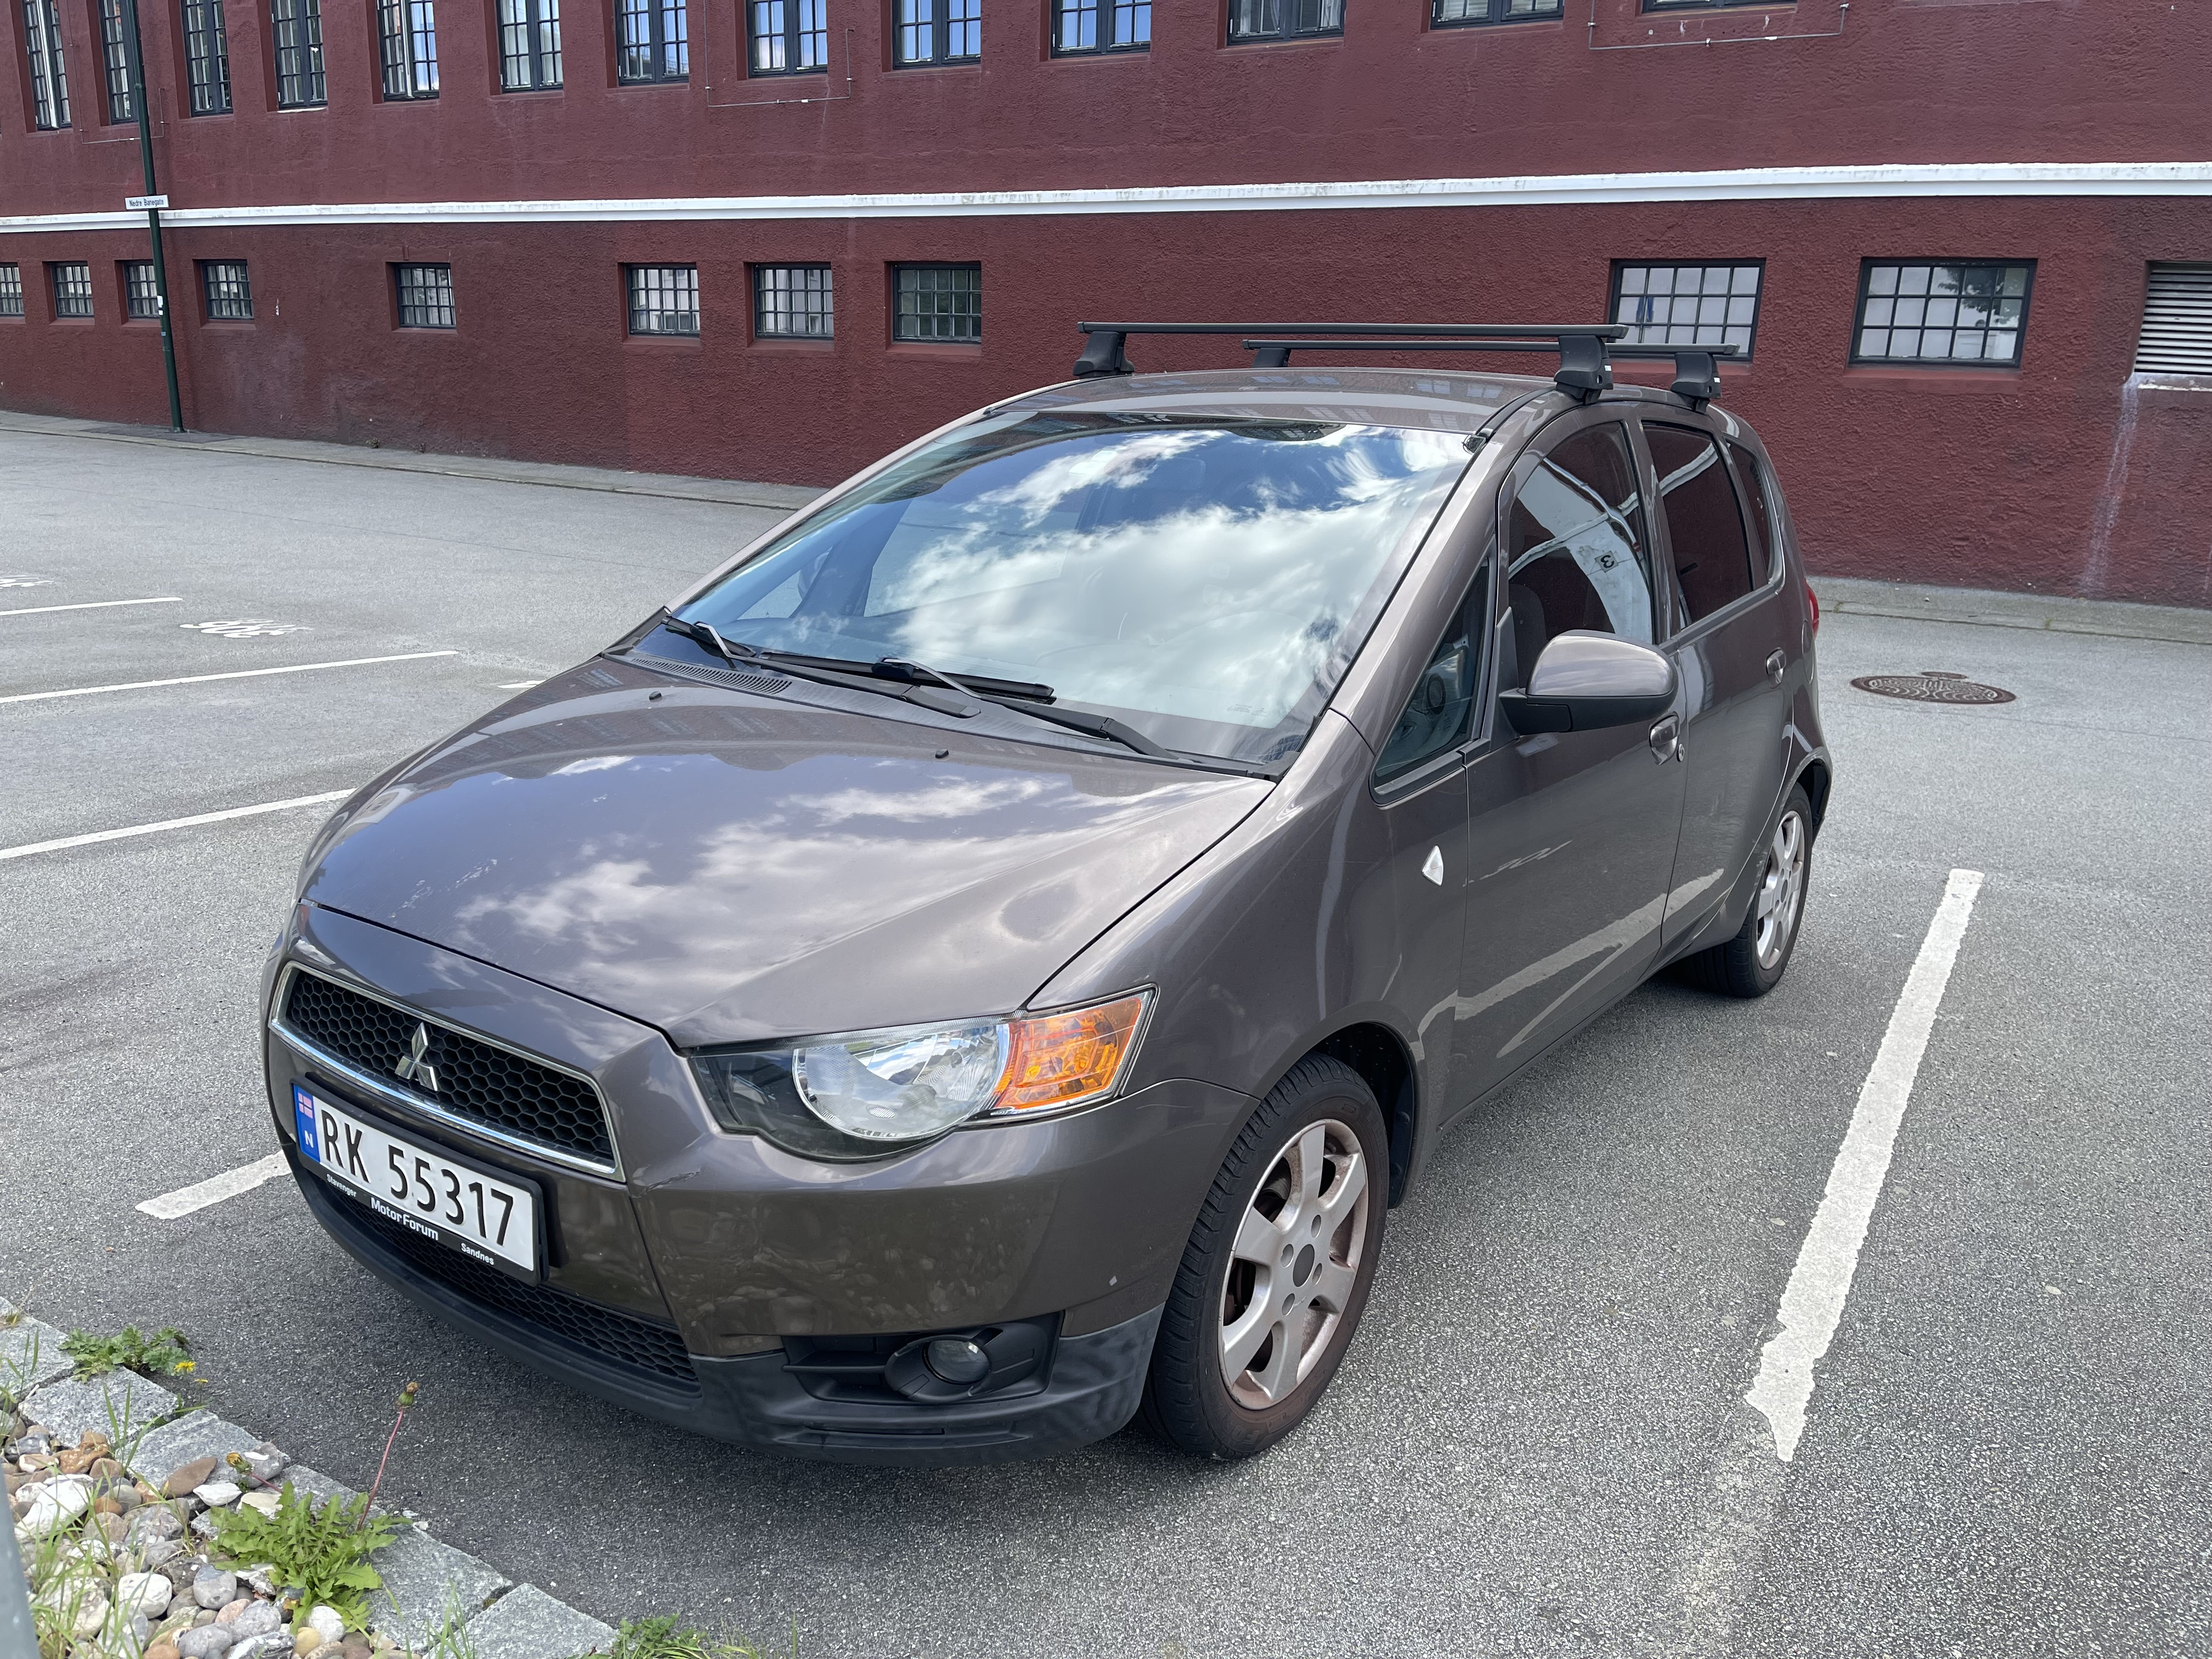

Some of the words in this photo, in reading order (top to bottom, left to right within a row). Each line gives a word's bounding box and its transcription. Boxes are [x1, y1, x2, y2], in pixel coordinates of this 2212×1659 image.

[144, 198, 164, 207] Banegate
[304, 1130, 314, 1148] N
[321, 1109, 370, 1183] RK
[388, 1144, 514, 1247] 55317
[326, 1173, 357, 1198] Stavanger
[461, 1243, 494, 1265] Sandnes
